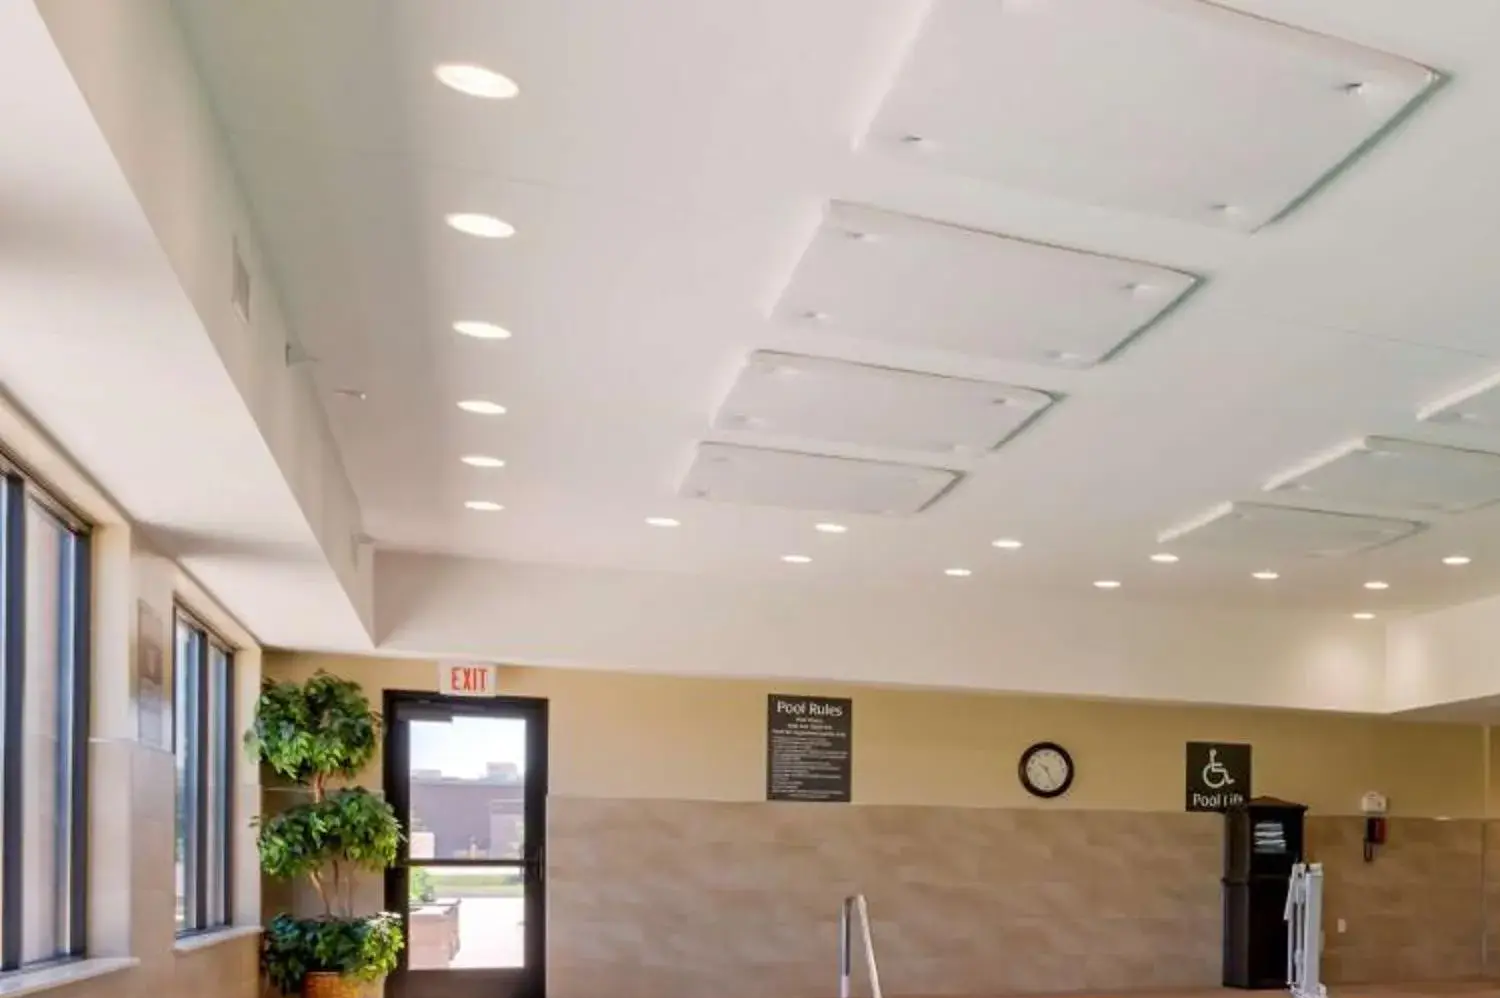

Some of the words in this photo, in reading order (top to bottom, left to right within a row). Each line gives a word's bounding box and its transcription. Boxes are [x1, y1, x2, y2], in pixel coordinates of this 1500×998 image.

[451, 667, 488, 692] EXIT
[776, 700, 807, 715] Pool
[809, 703, 843, 717] Rules
[1193, 793, 1221, 807] Pool
